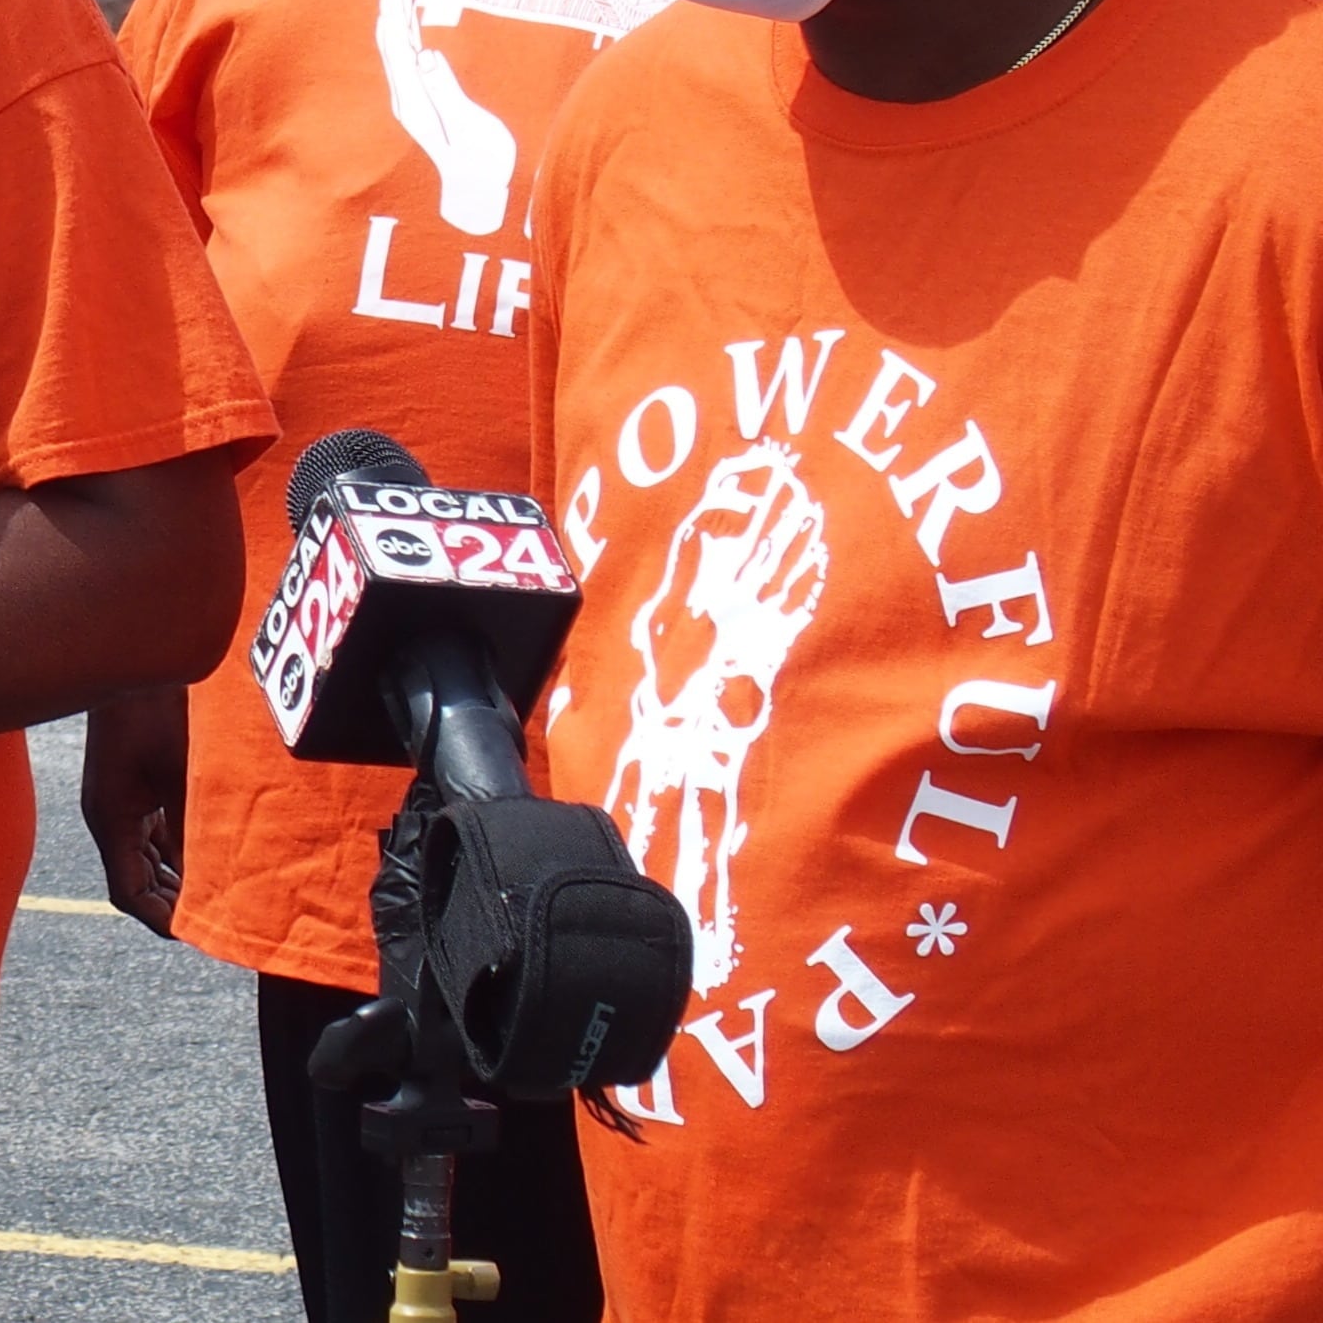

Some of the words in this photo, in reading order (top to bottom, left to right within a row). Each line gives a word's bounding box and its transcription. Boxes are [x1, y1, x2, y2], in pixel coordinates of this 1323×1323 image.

[352, 215, 531, 339] LIF
[343, 485, 540, 525] LOCAL
[376, 536, 433, 558] abc
[443, 526, 567, 588] 24
[252, 512, 334, 675] LOCAL
[303, 535, 359, 668] 24
